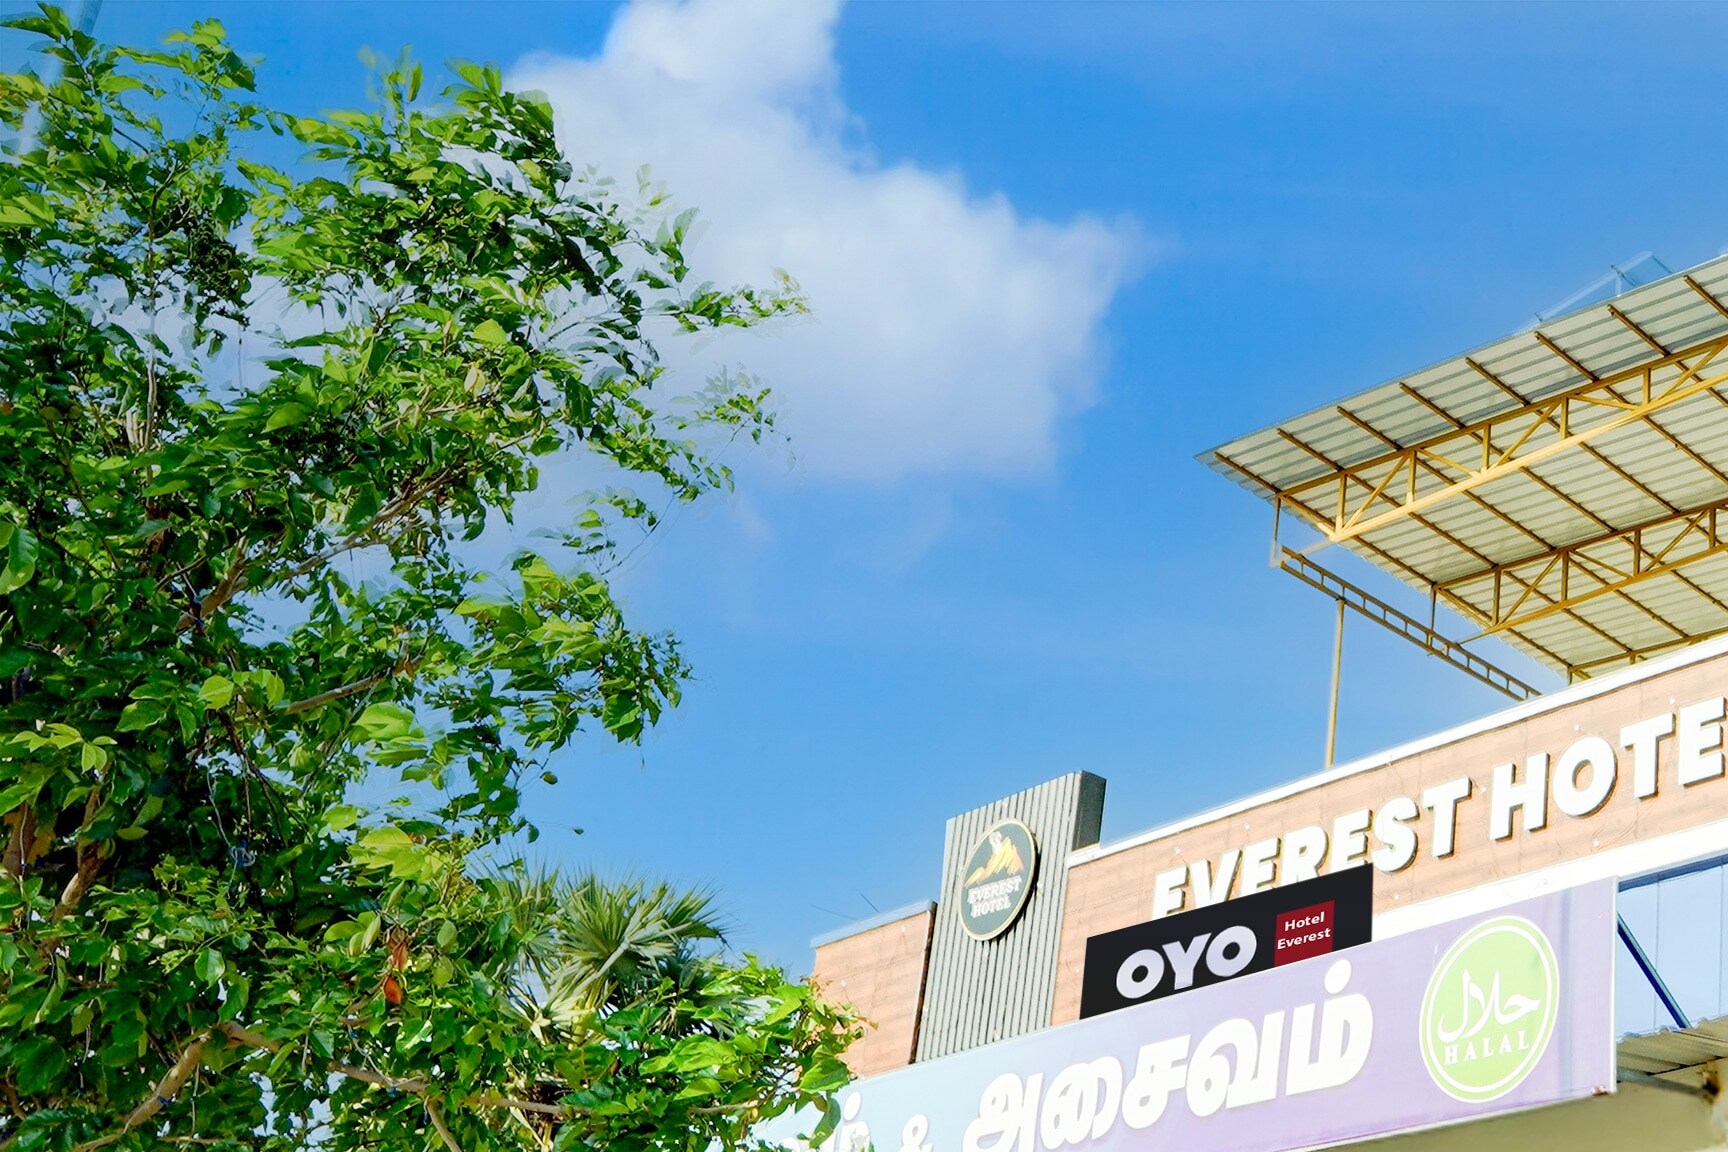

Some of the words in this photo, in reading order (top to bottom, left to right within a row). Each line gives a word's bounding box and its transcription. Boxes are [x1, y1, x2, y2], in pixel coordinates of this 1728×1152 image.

[1150, 776, 1474, 920] EVEREST
[967, 875, 1022, 905] EVEREST
[970, 893, 1012, 918] HOTEL
[1284, 911, 1325, 932] Hotel
[1276, 927, 1331, 950] Everest
[1116, 925, 1258, 999] OYO
[1437, 969, 1541, 1043] حلال
[1443, 1030, 1530, 1066] HALAL
